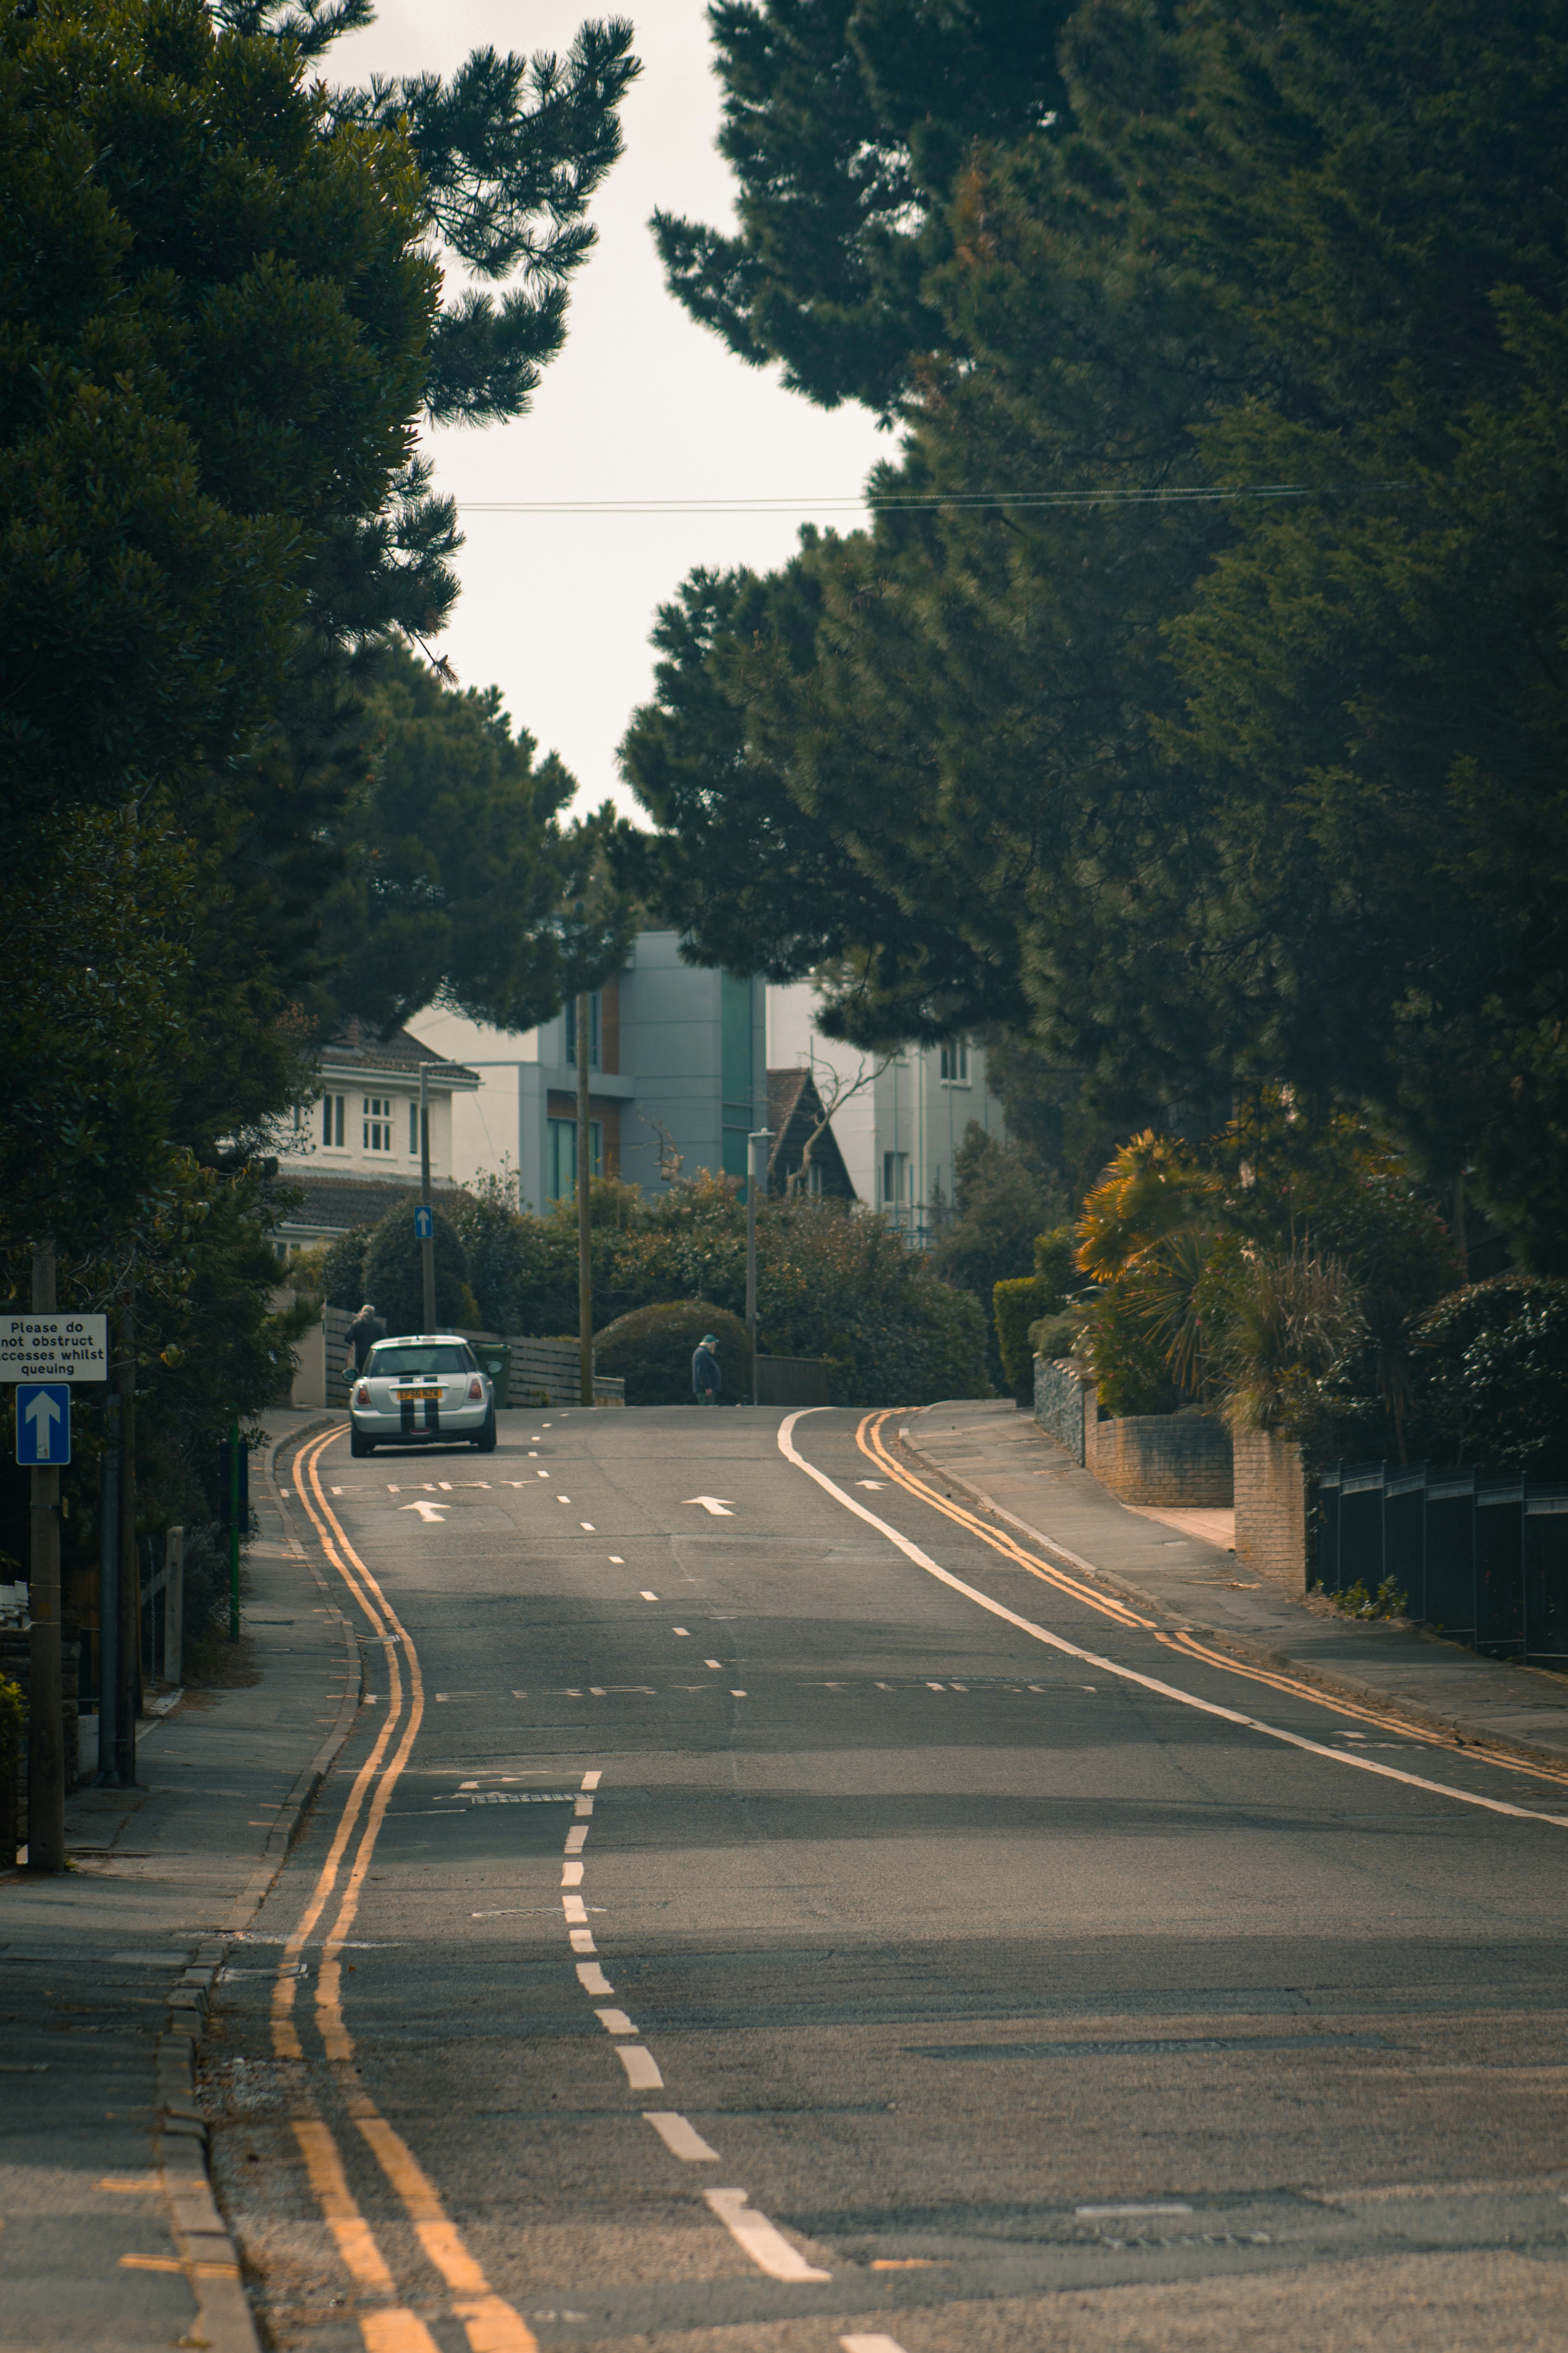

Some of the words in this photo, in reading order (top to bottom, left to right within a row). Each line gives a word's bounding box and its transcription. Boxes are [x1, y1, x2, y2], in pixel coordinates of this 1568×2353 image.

[11, 1322, 57, 1333] Please
[66, 1321, 83, 1332] do
[1, 1336, 24, 1347] not
[32, 1336, 94, 1346] obstruct
[0, 1352, 55, 1360] ccesses
[61, 1349, 104, 1360] whilst
[21, 1364, 74, 1376] queuing
[400, 1390, 420, 1398] EF56
